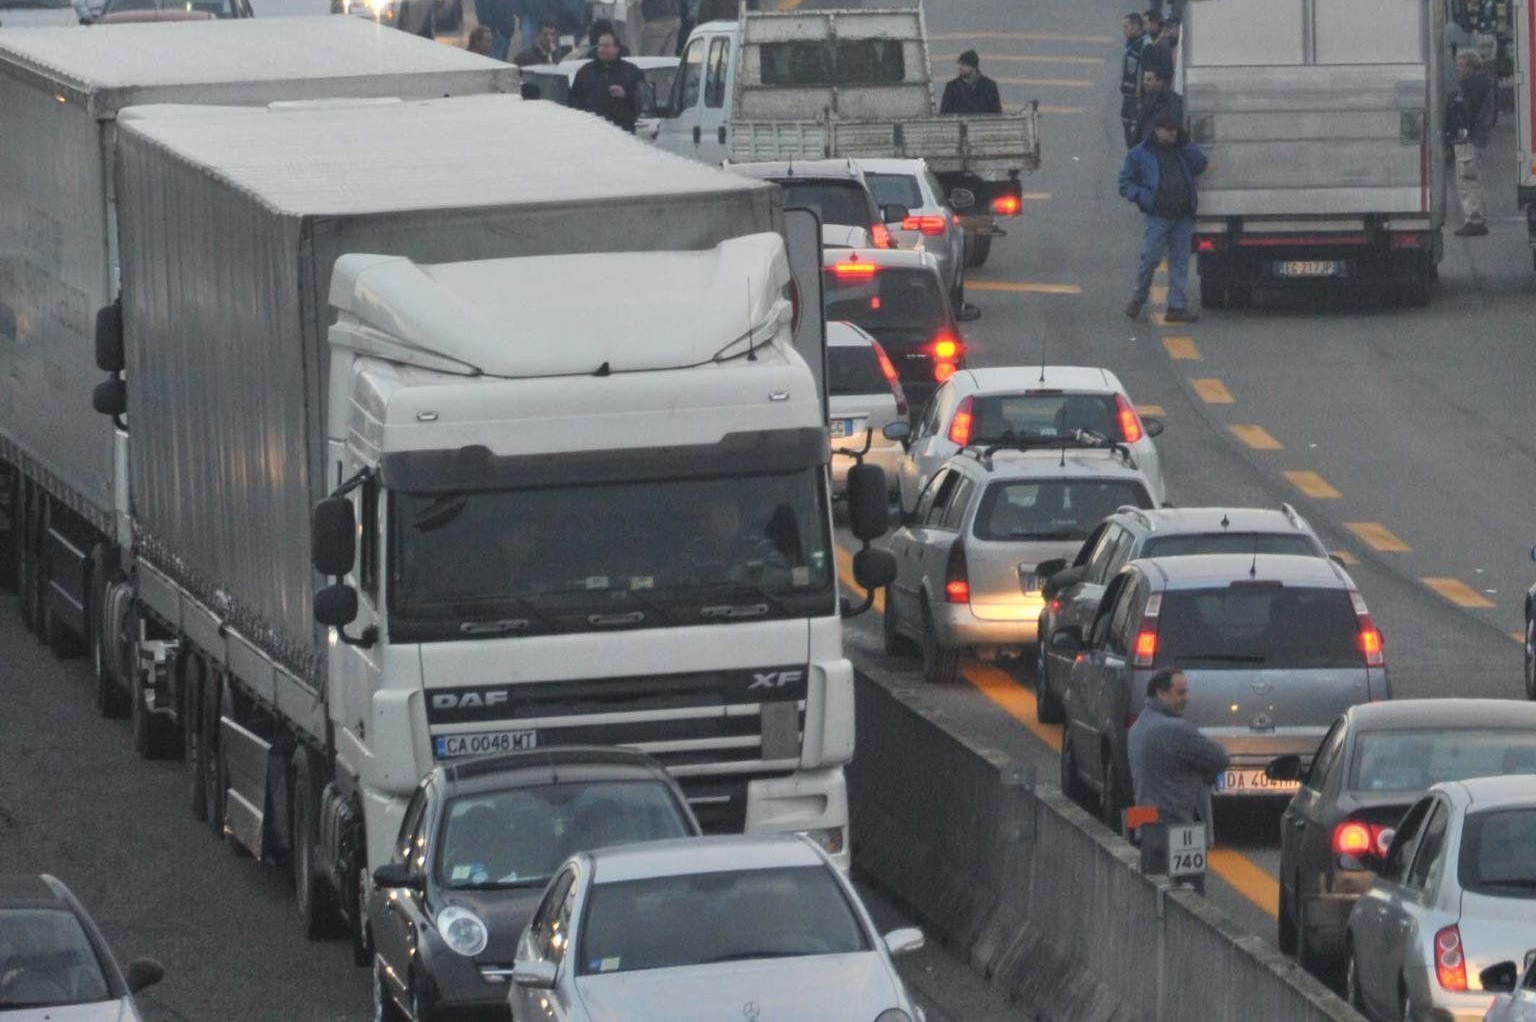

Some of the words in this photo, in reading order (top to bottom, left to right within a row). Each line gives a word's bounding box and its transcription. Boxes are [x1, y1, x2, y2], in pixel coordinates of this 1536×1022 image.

[746, 671, 801, 690] XF
[432, 690, 509, 709] DAF
[1174, 853, 1204, 869] 740
